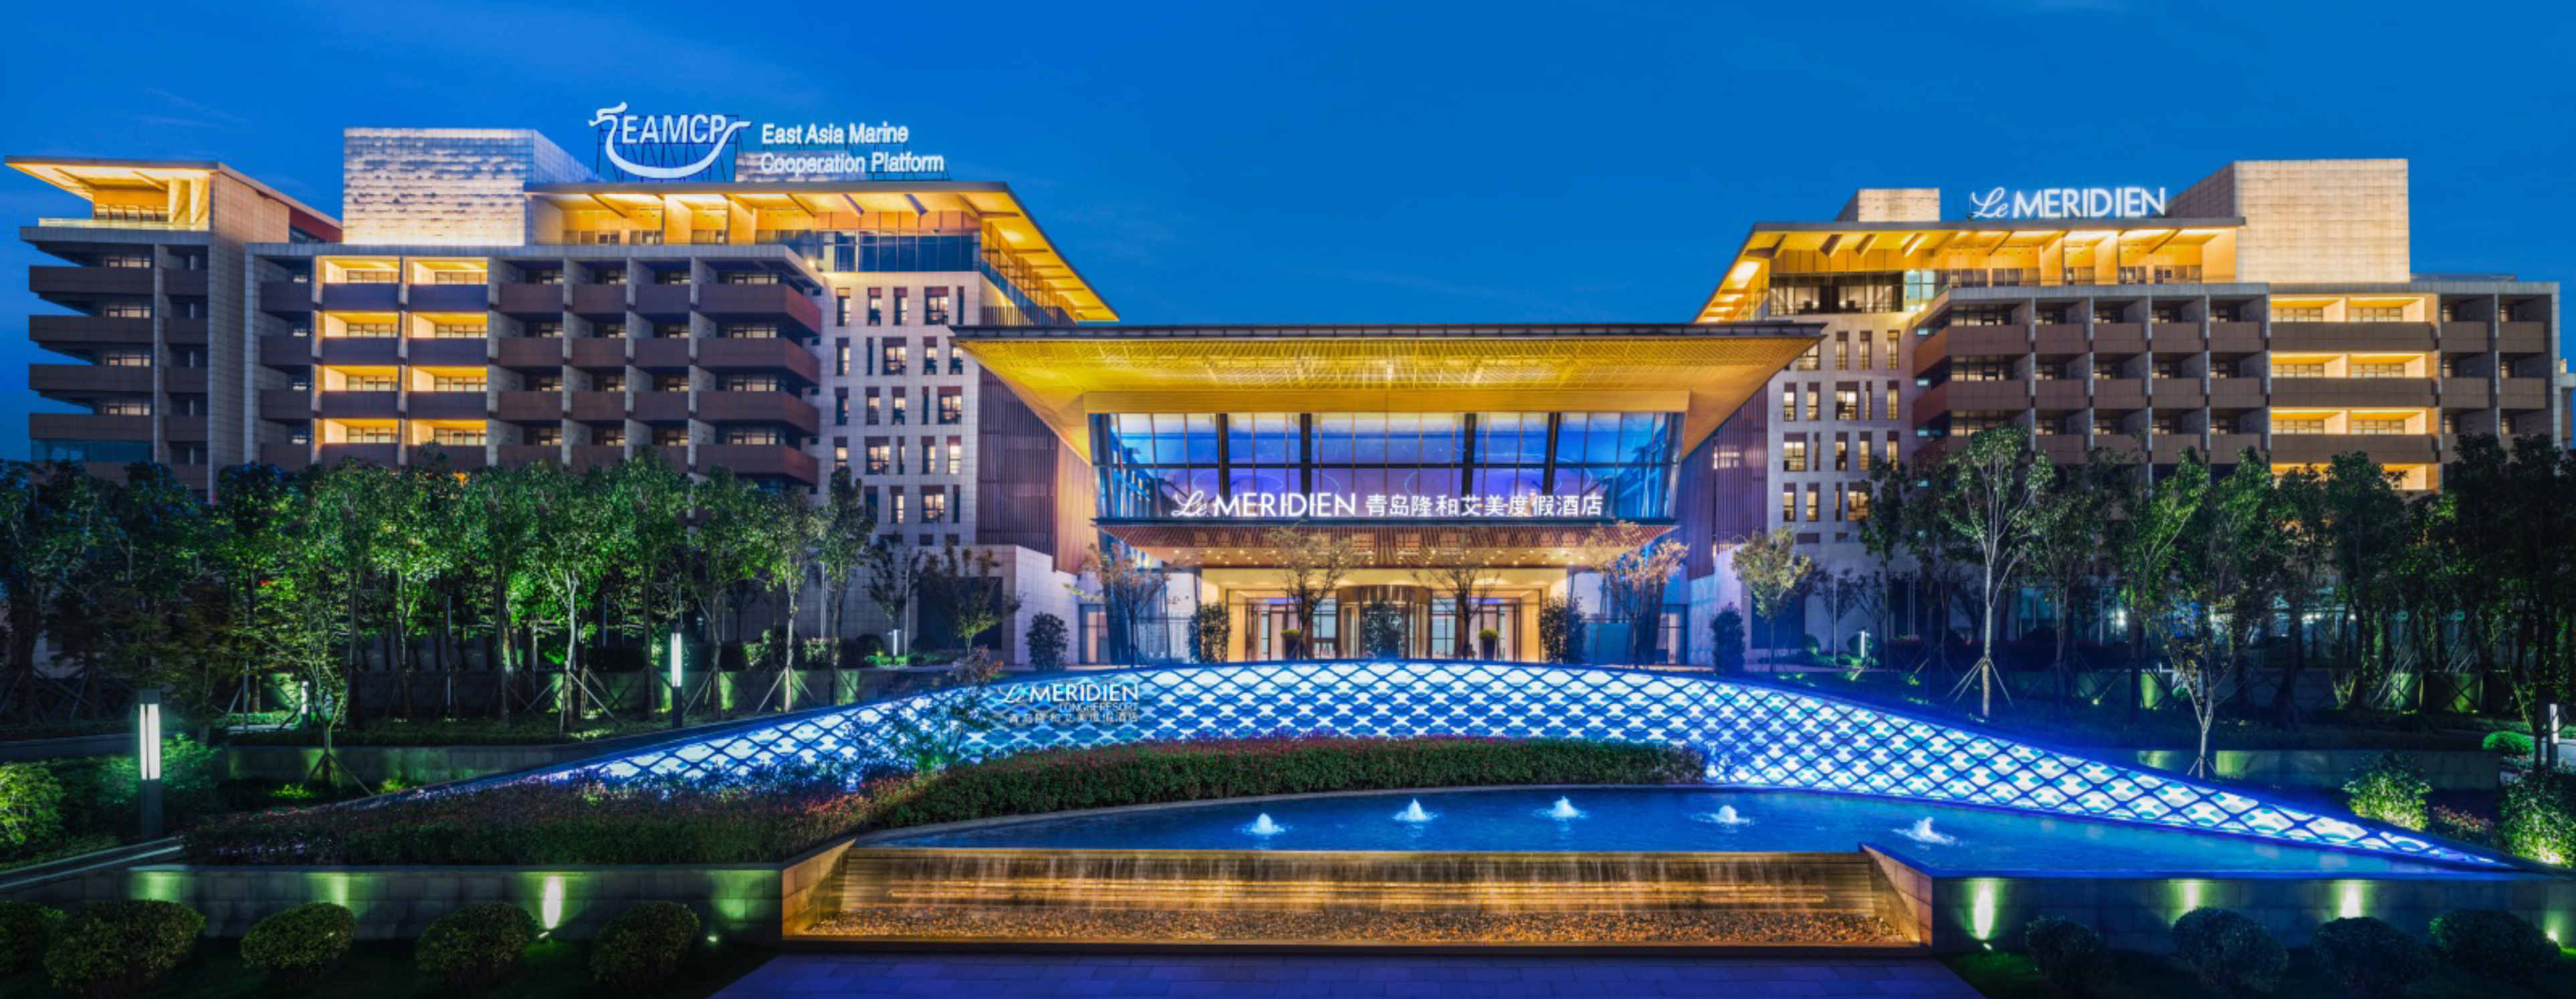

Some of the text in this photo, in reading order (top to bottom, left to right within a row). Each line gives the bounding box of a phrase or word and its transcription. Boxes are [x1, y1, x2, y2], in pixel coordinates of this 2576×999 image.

[622, 114, 727, 144] EAMCP
[761, 120, 909, 144] East Asia Marine
[760, 151, 944, 175] Cooperation Platform
[1971, 187, 2166, 219] Le MERIDIEN
[1171, 490, 1604, 518] Le MERIDIEN 青岛隆和艾美度假酒店
[1029, 683, 1138, 703] MERIDIEN
